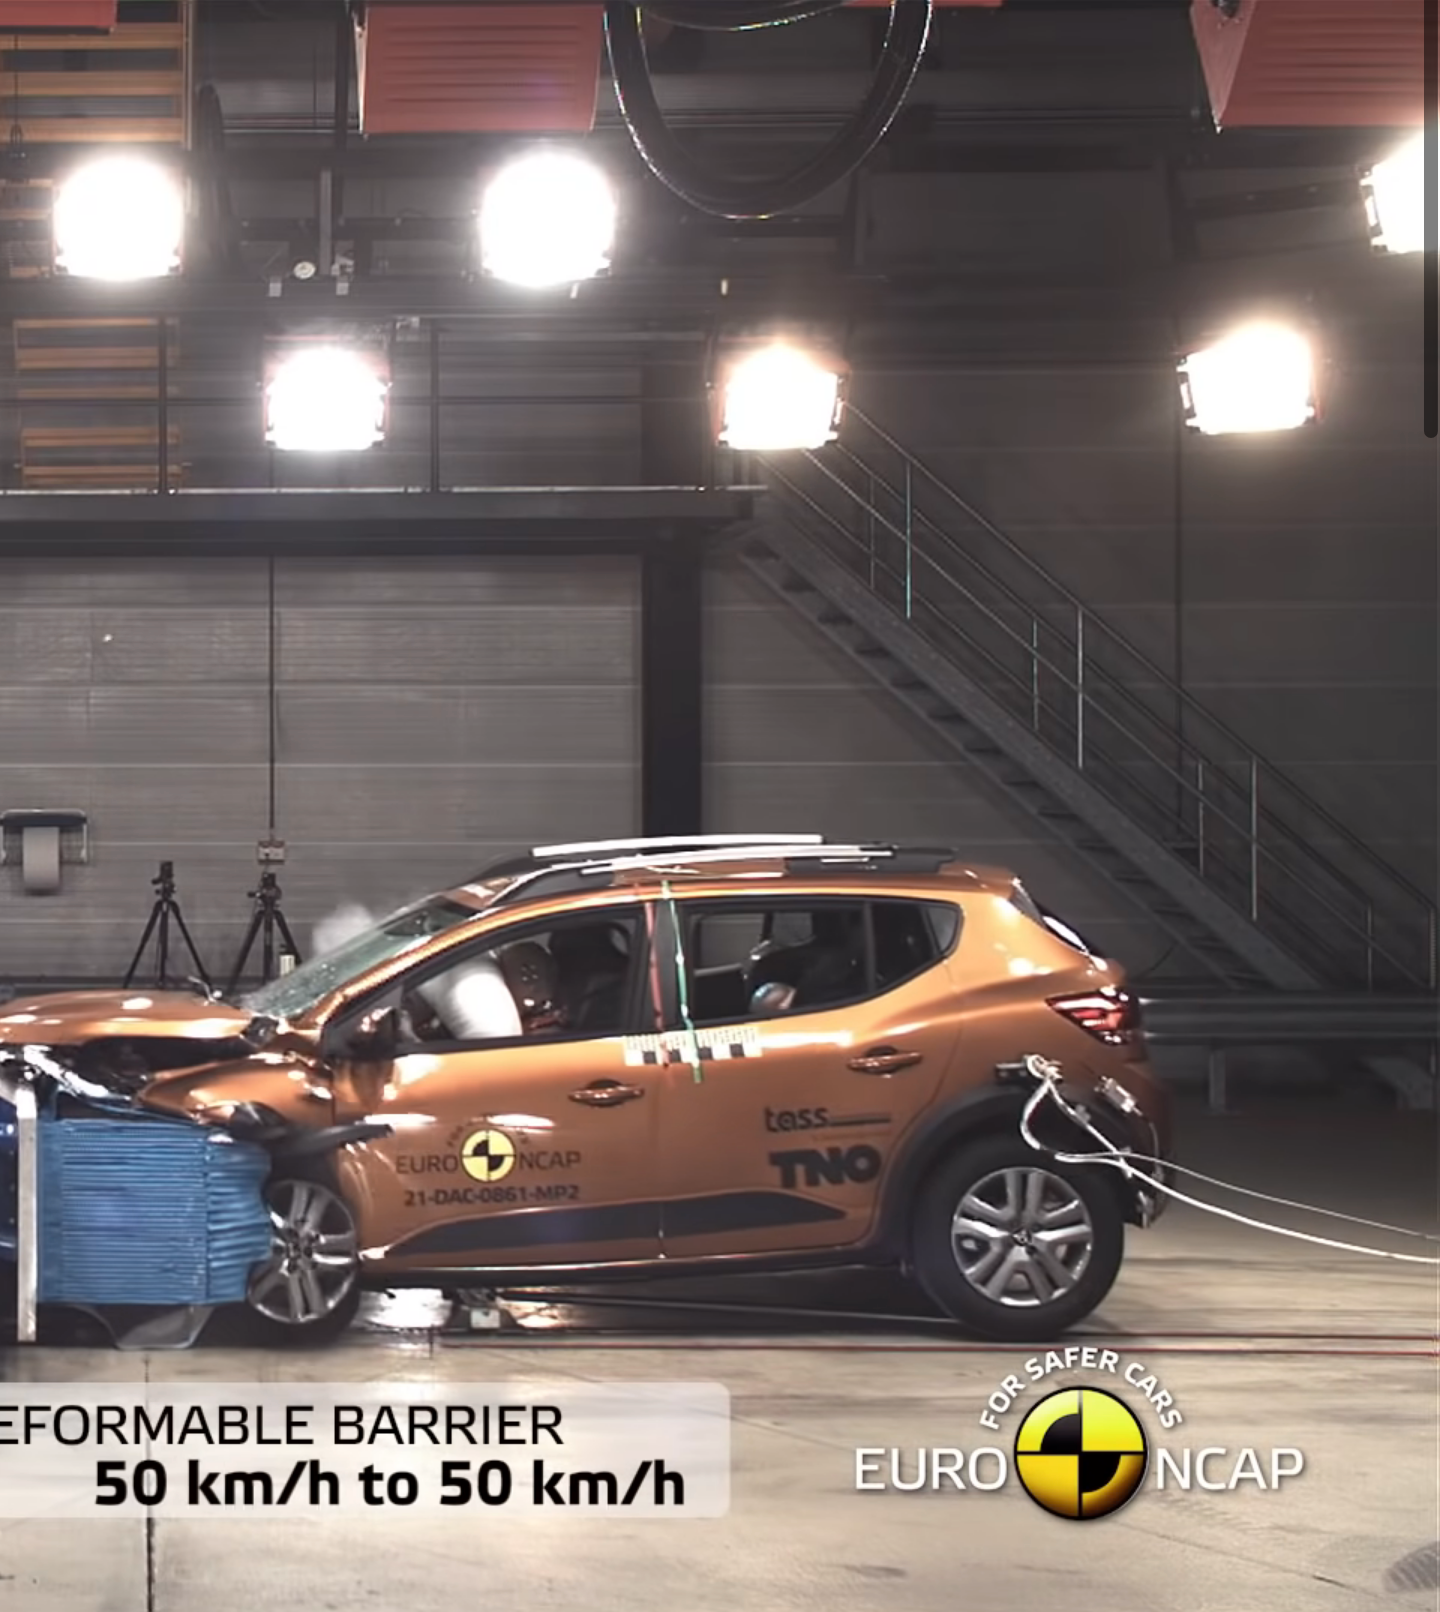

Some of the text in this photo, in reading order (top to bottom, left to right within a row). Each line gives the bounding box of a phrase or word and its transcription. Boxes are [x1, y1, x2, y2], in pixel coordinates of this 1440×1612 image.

[764, 1107, 829, 1133] tass
[395, 1151, 581, 1174] EURO NCAP
[768, 1144, 882, 1189] TNO
[403, 1184, 580, 1207] 21-DAC-0861-MP2
